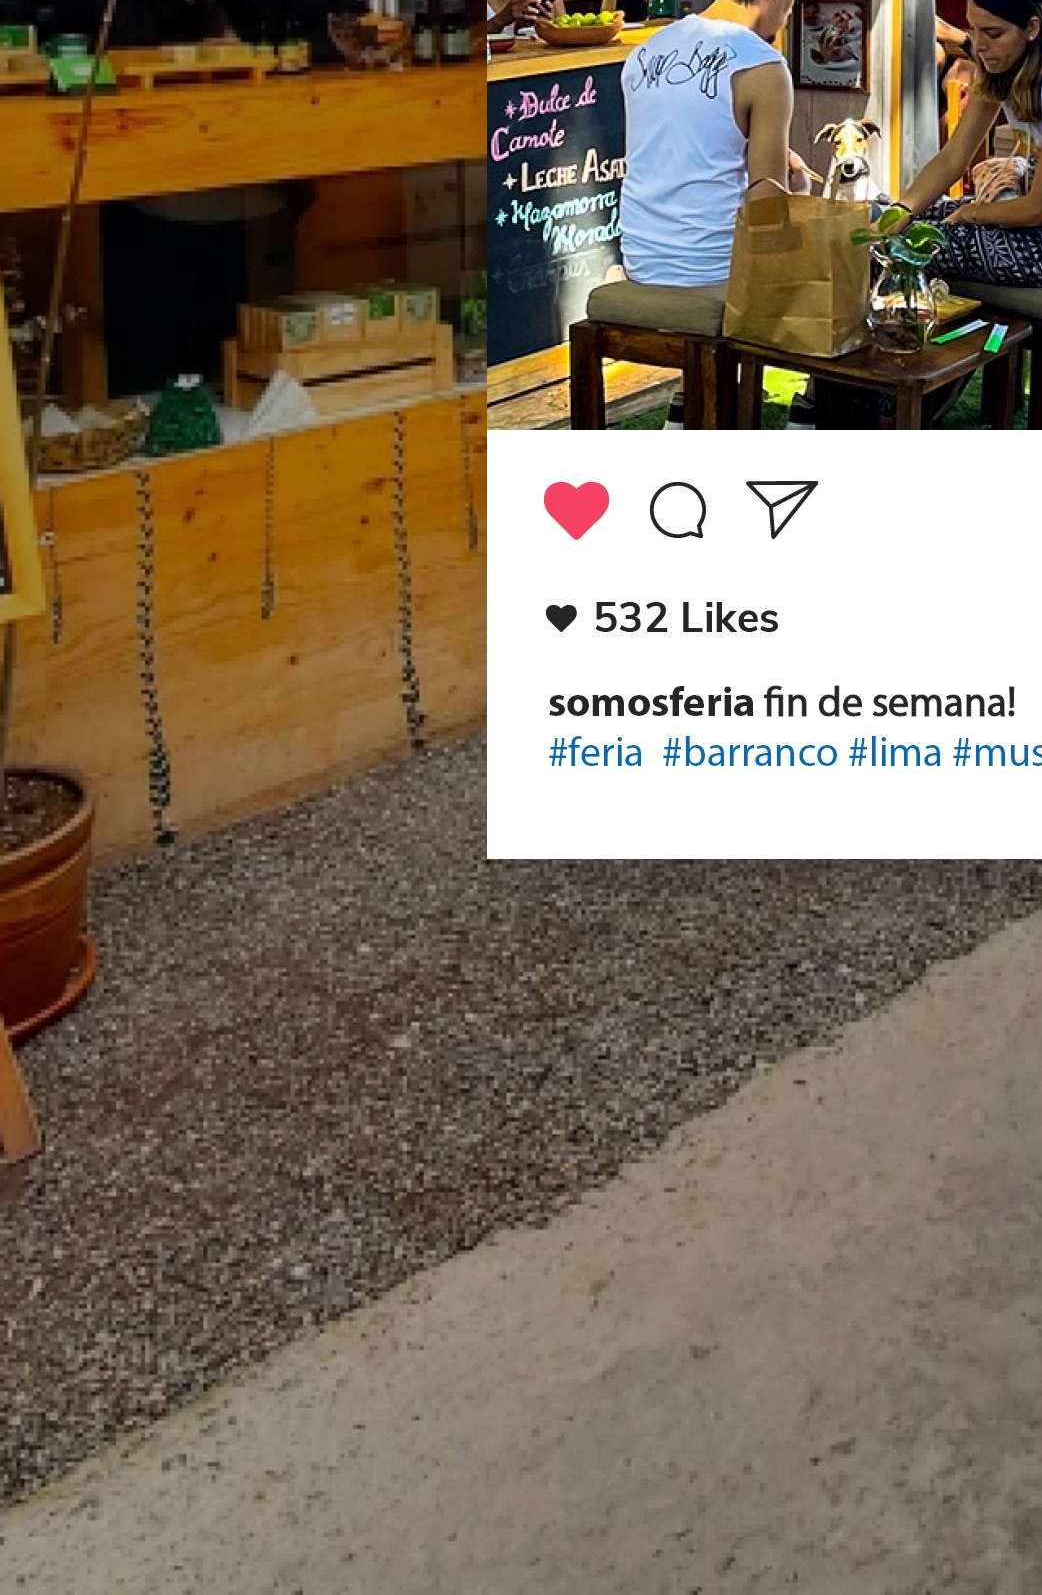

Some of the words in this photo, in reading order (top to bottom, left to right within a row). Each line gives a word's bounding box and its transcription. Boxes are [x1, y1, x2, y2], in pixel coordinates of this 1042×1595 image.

[518, 83, 571, 121] Dulce
[576, 75, 598, 107] de
[490, 118, 566, 162] Camote
[551, 207, 621, 255] Morad
